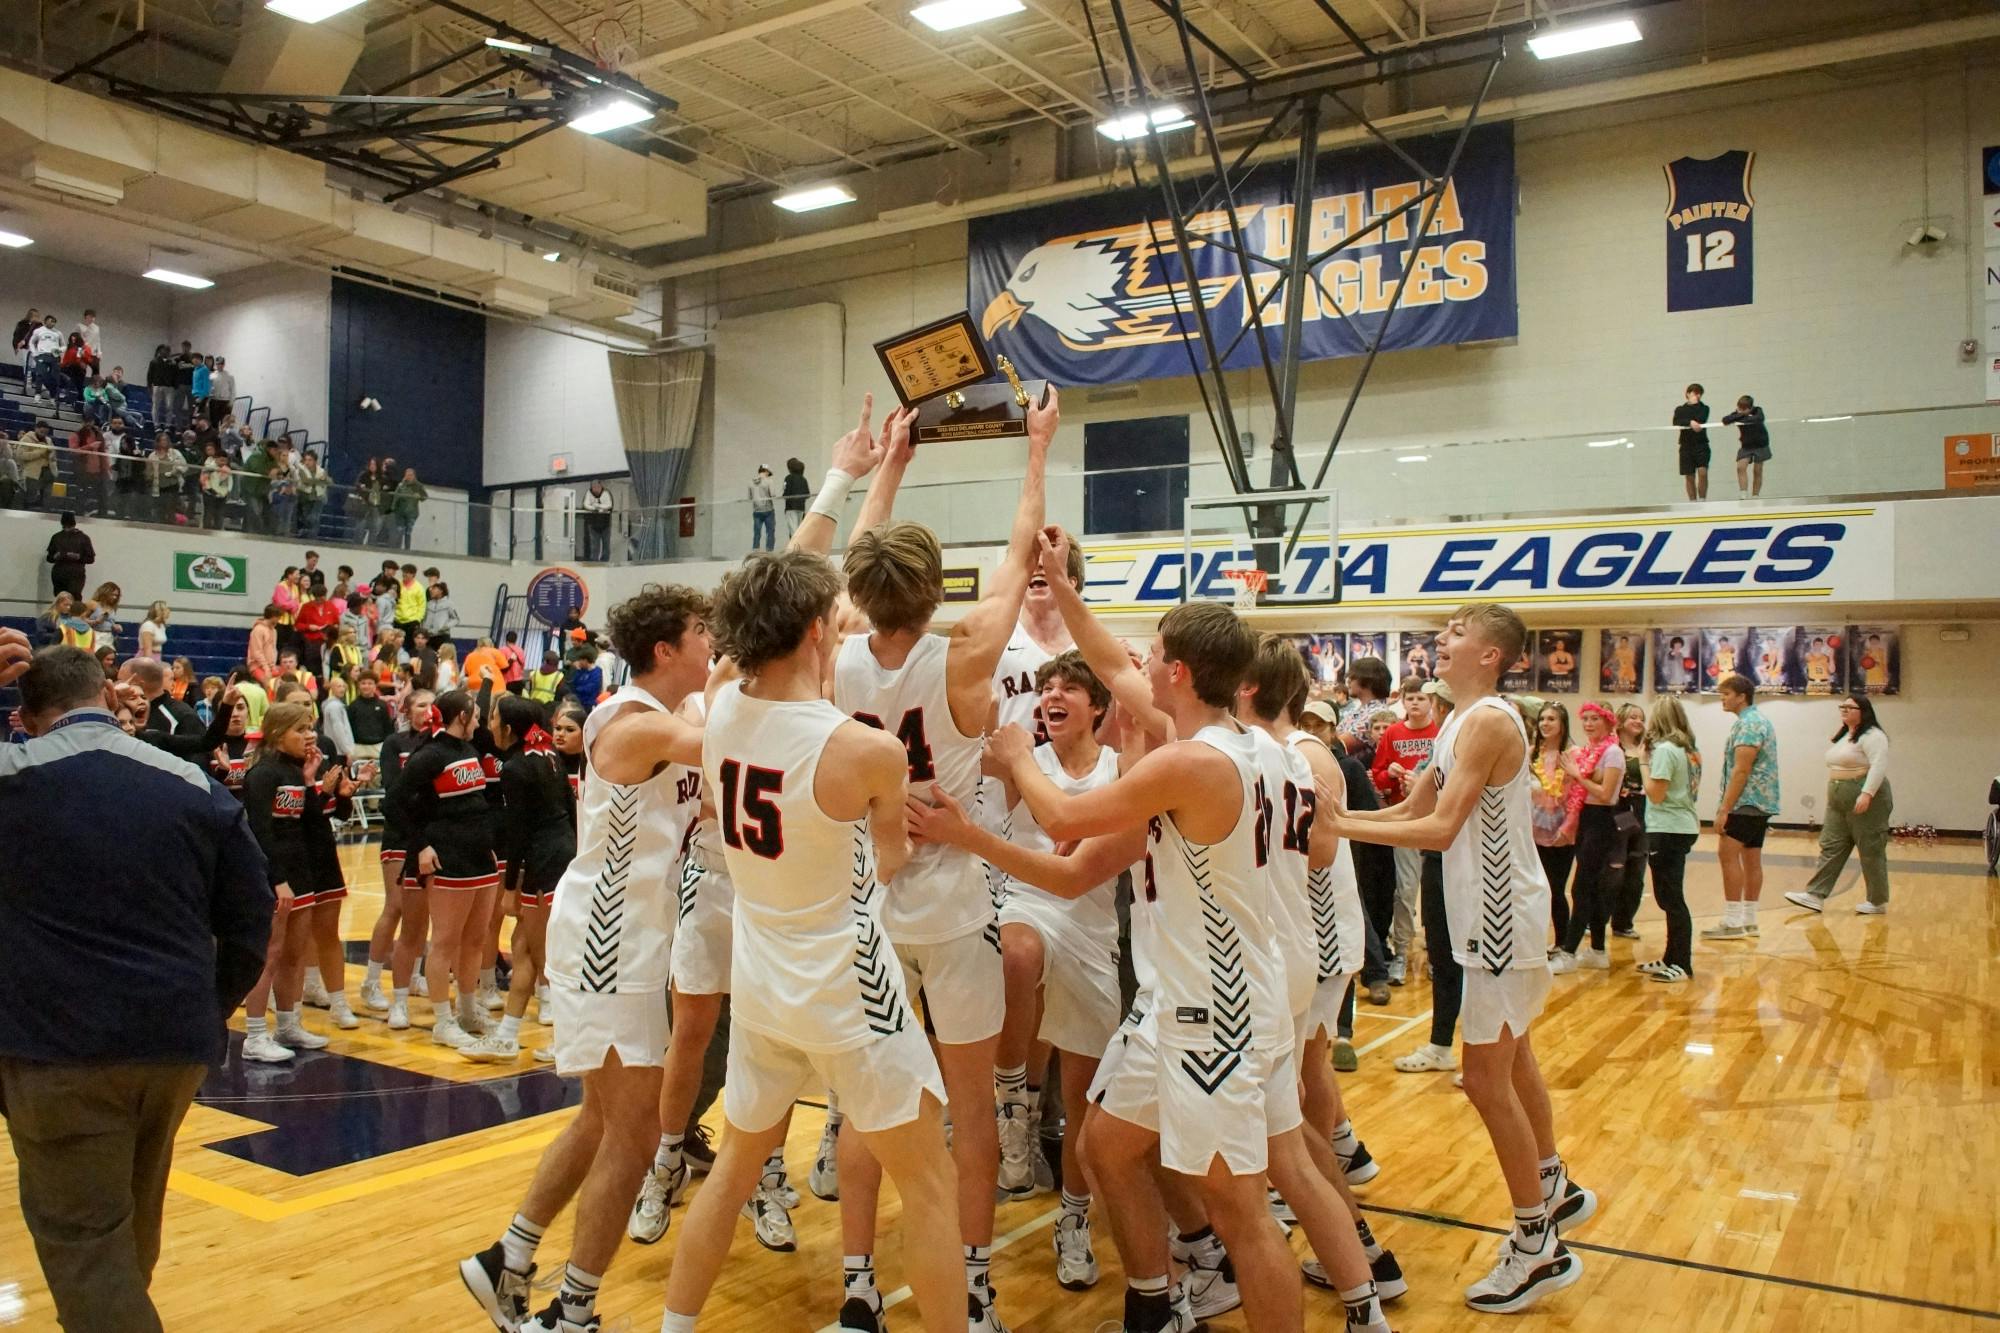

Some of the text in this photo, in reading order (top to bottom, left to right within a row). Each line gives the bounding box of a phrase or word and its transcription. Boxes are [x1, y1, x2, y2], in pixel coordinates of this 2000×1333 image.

[1263, 176, 1464, 261] DELTA
[1669, 201, 1750, 231] PAINTER
[1686, 230, 1735, 273] 12
[1241, 240, 1488, 329] EAGLES
[1135, 523, 1847, 601] DETA EAGLES
[720, 758, 784, 860] 15
[1283, 780, 1315, 855] 12
